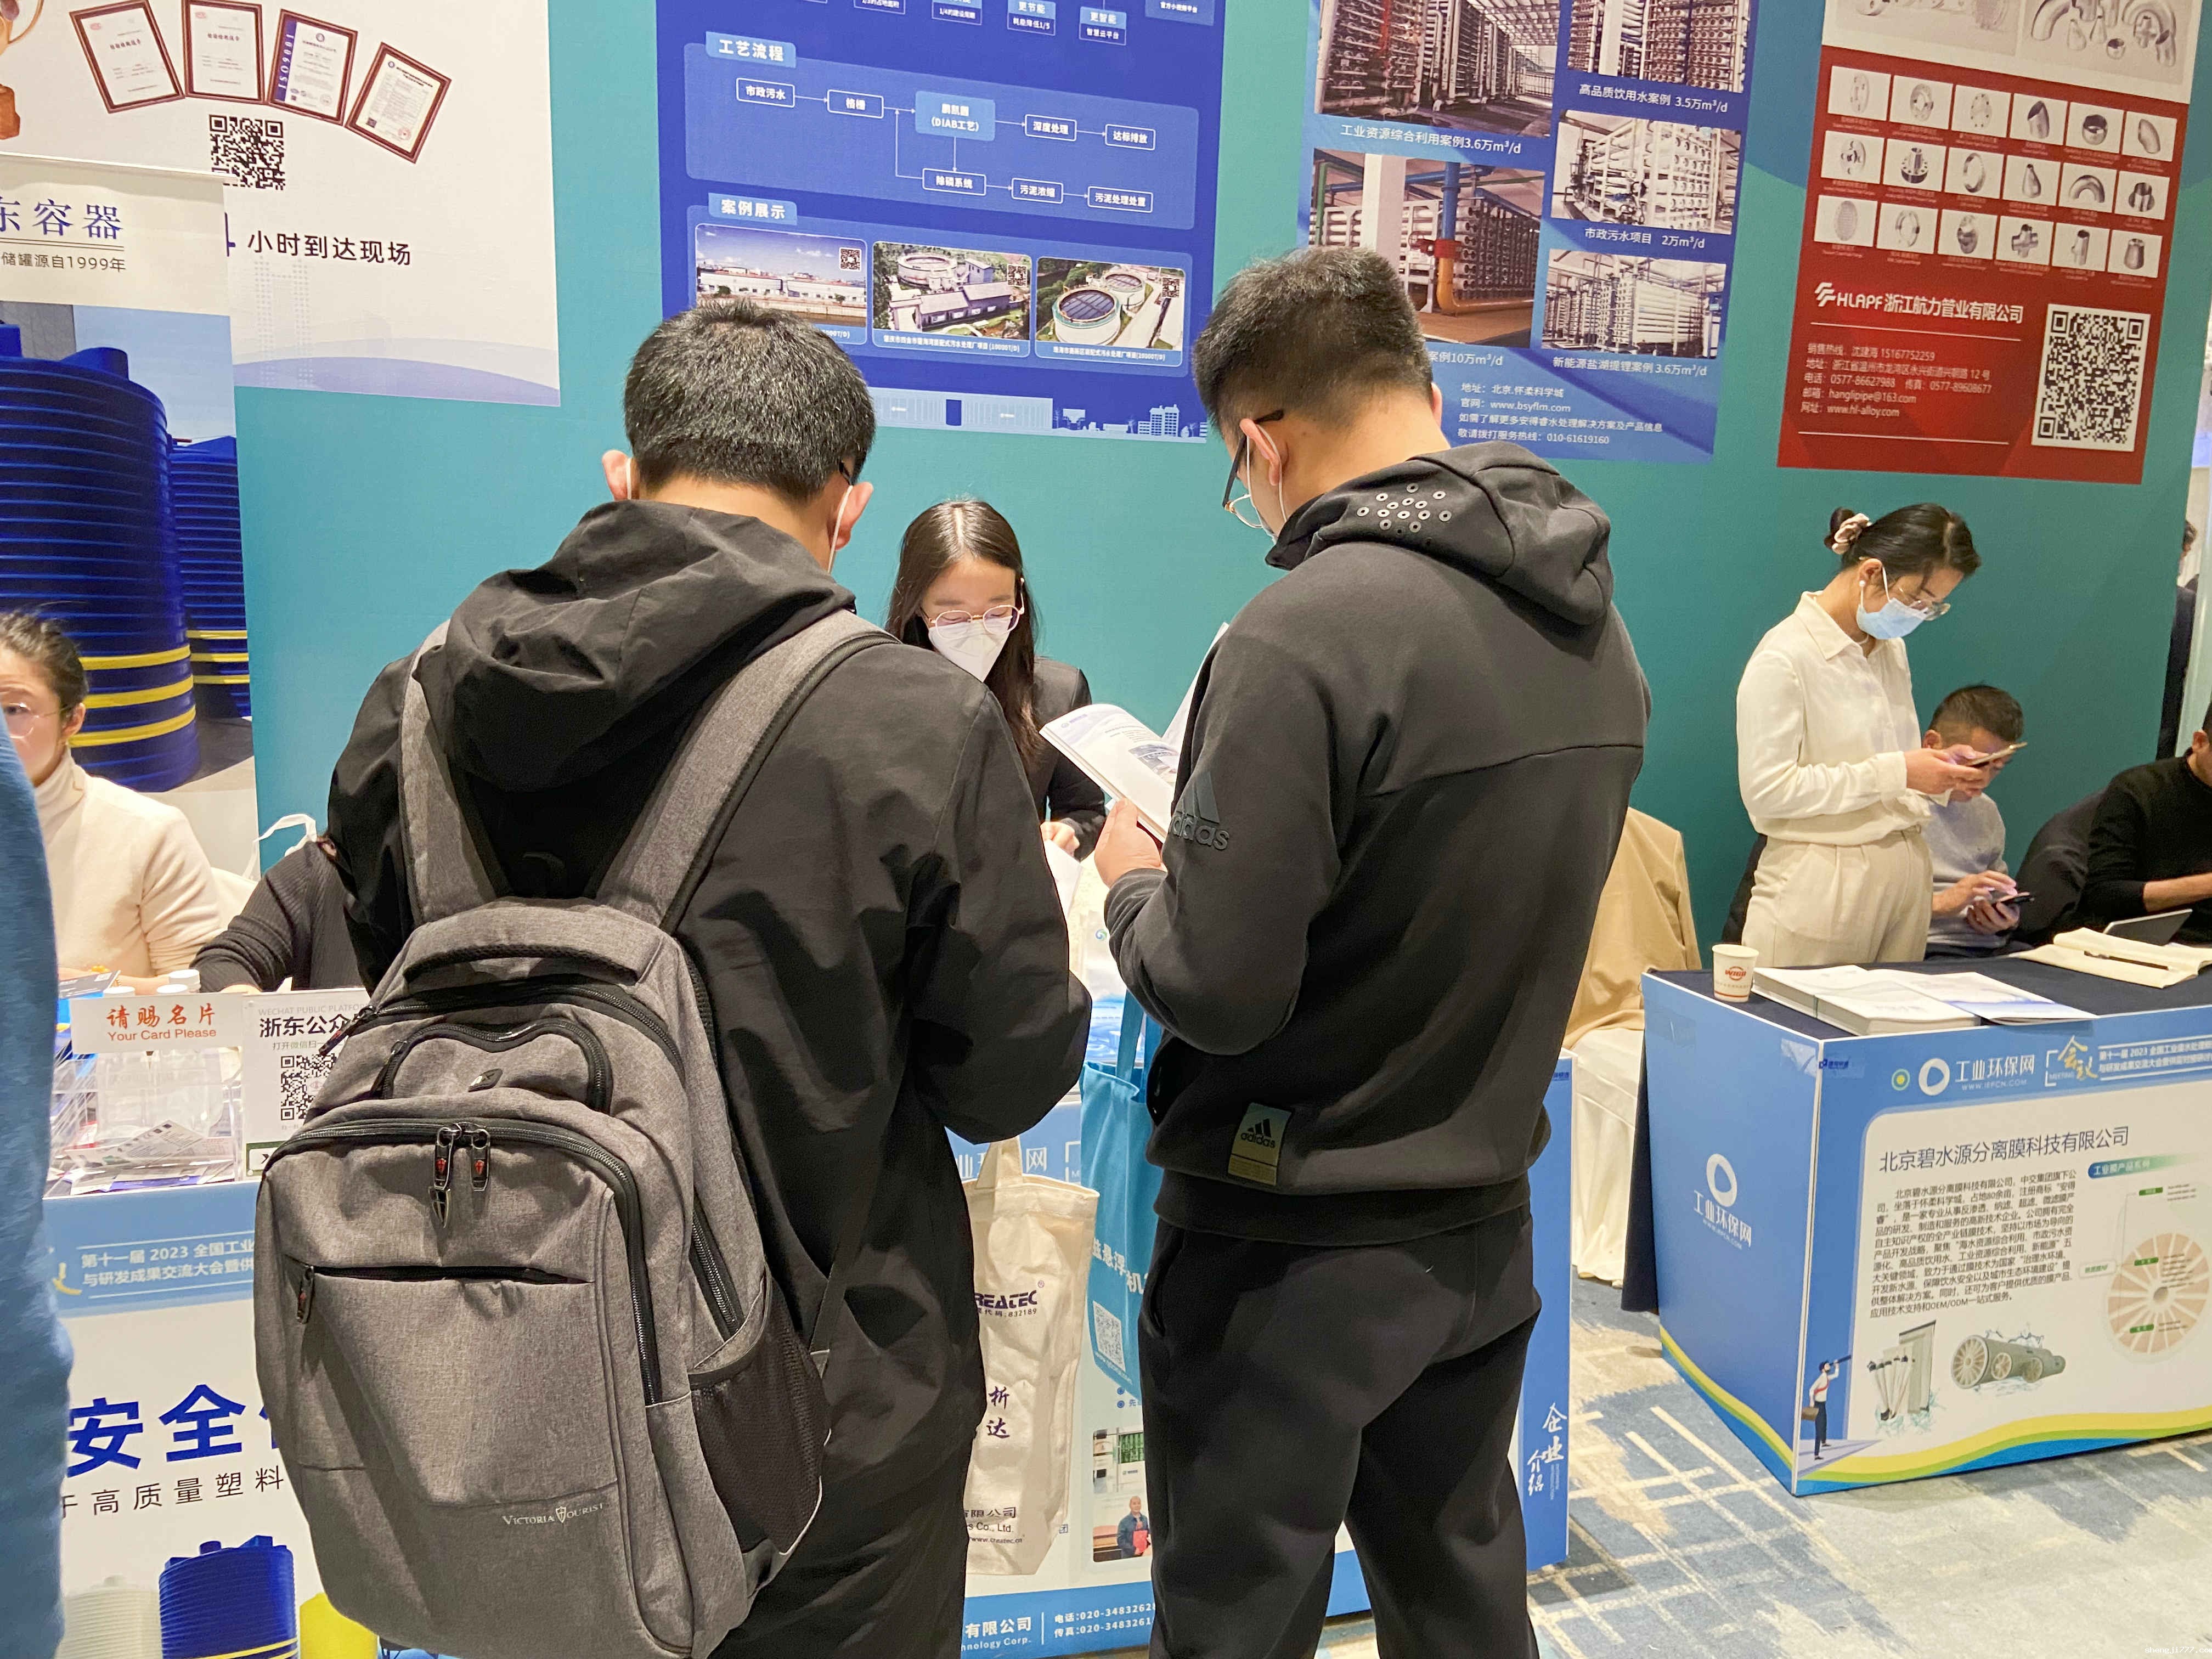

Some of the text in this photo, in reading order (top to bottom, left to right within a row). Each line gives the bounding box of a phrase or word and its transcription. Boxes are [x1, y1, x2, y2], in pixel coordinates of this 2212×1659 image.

[719, 39, 784, 62] 工艺流程
[746, 85, 786, 101] 市政污水
[1579, 83, 1671, 106] 高品质饮用水案例
[1032, 121, 1069, 136] 深度处理
[1113, 131, 1148, 144] 达标排放
[721, 199, 786, 219] 案例展示
[1585, 228, 1652, 245] 市政污水项目
[247, 230, 411, 266] 小时到达现场
[1, 252, 126, 273] 储罐源自1999年
[1884, 293, 2024, 324] 浙江航力管业有限公司
[106, 1003, 216, 1029] 请赐名片
[258, 1007, 294, 1015] WECHAT
[108, 1028, 216, 1041] Your Card Please
[1955, 1054, 2035, 1083] 工业环保网
[1240, 1132, 1276, 1149] adidas
[1878, 1126, 2129, 1173] 北京碧水源分离膜科技有限公司
[1694, 1189, 1751, 1248] 工业环保网
[82, 1250, 145, 1269] 第十一届
[150, 1246, 188, 1261] 2023
[67, 1384, 278, 1478] 安全
[501, 1515, 555, 1525] VICTORIA
[965, 1617, 1032, 1638] 有限公司
[1003, 1636, 1032, 1645] Corp.
